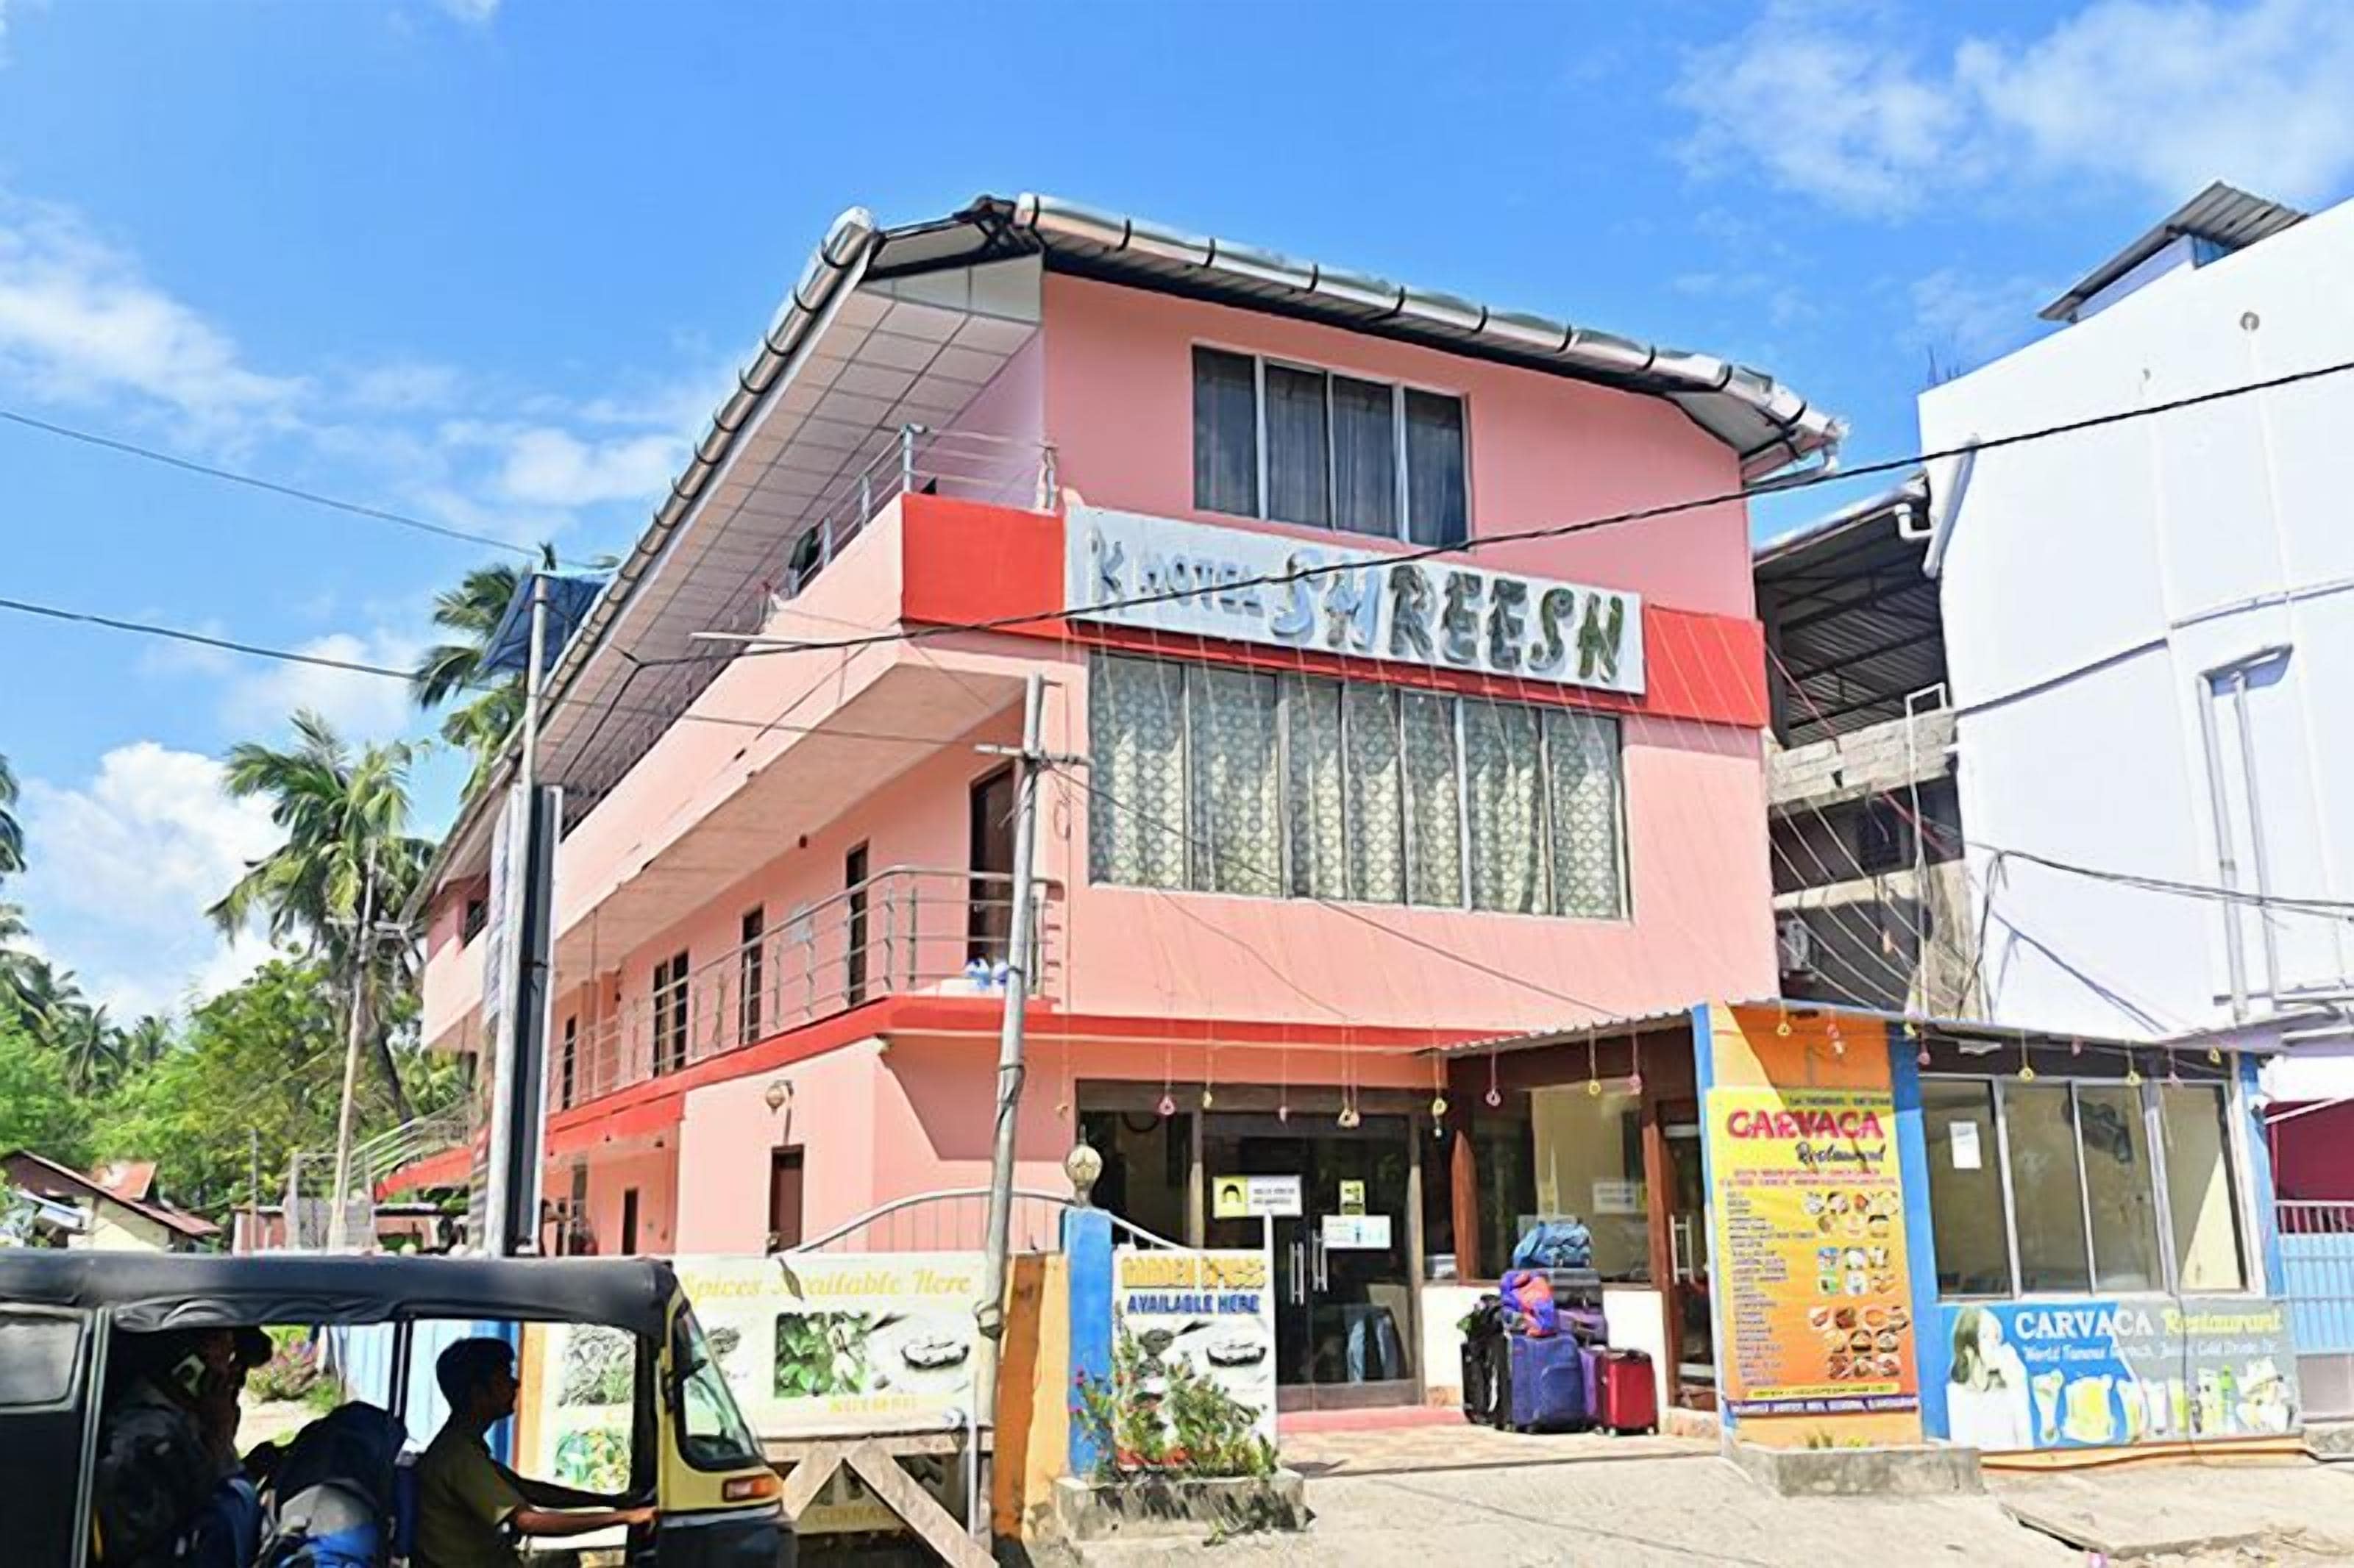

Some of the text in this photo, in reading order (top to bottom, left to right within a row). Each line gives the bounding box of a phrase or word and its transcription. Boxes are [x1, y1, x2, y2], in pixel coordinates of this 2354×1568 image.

[1090, 527, 1126, 618] K
[1727, 1109, 1885, 1138] CARVACA
[1127, 1294, 1260, 1314] AVAILABLE HERE
[2015, 1309, 2155, 1339] CARVACA
